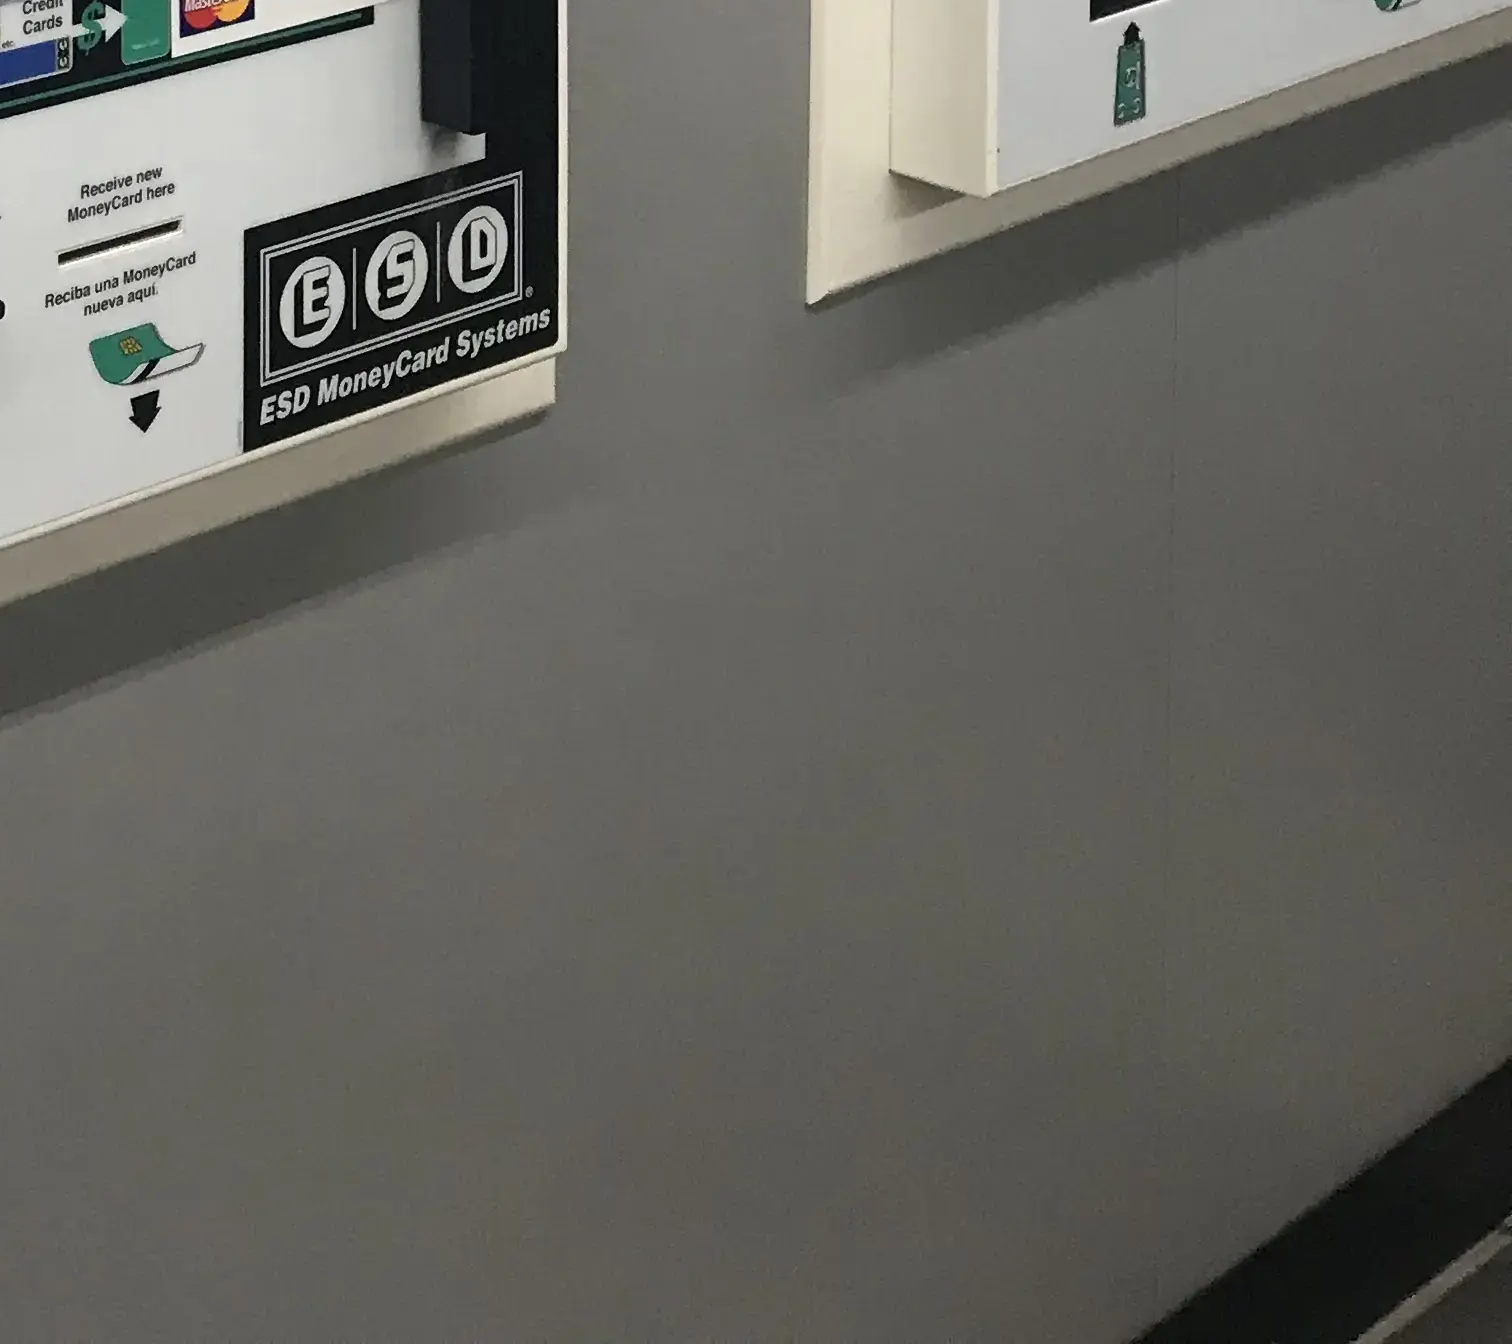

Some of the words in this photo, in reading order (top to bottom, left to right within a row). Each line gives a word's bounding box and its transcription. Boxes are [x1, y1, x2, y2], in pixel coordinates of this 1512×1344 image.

[23, 15, 62, 34] Cards
[81, 176, 132, 199] Receive
[137, 167, 162, 183] new
[68, 190, 142, 222] MoneyCard
[147, 183, 175, 200] here
[45, 286, 90, 308] Reciba
[95, 278, 119, 293] una
[124, 251, 196, 284] MoneyCard
[84, 295, 123, 316] nueva
[260, 385, 310, 425] ESD
[318, 338, 449, 405] MoneyCard
[456, 309, 550, 358] Systems
